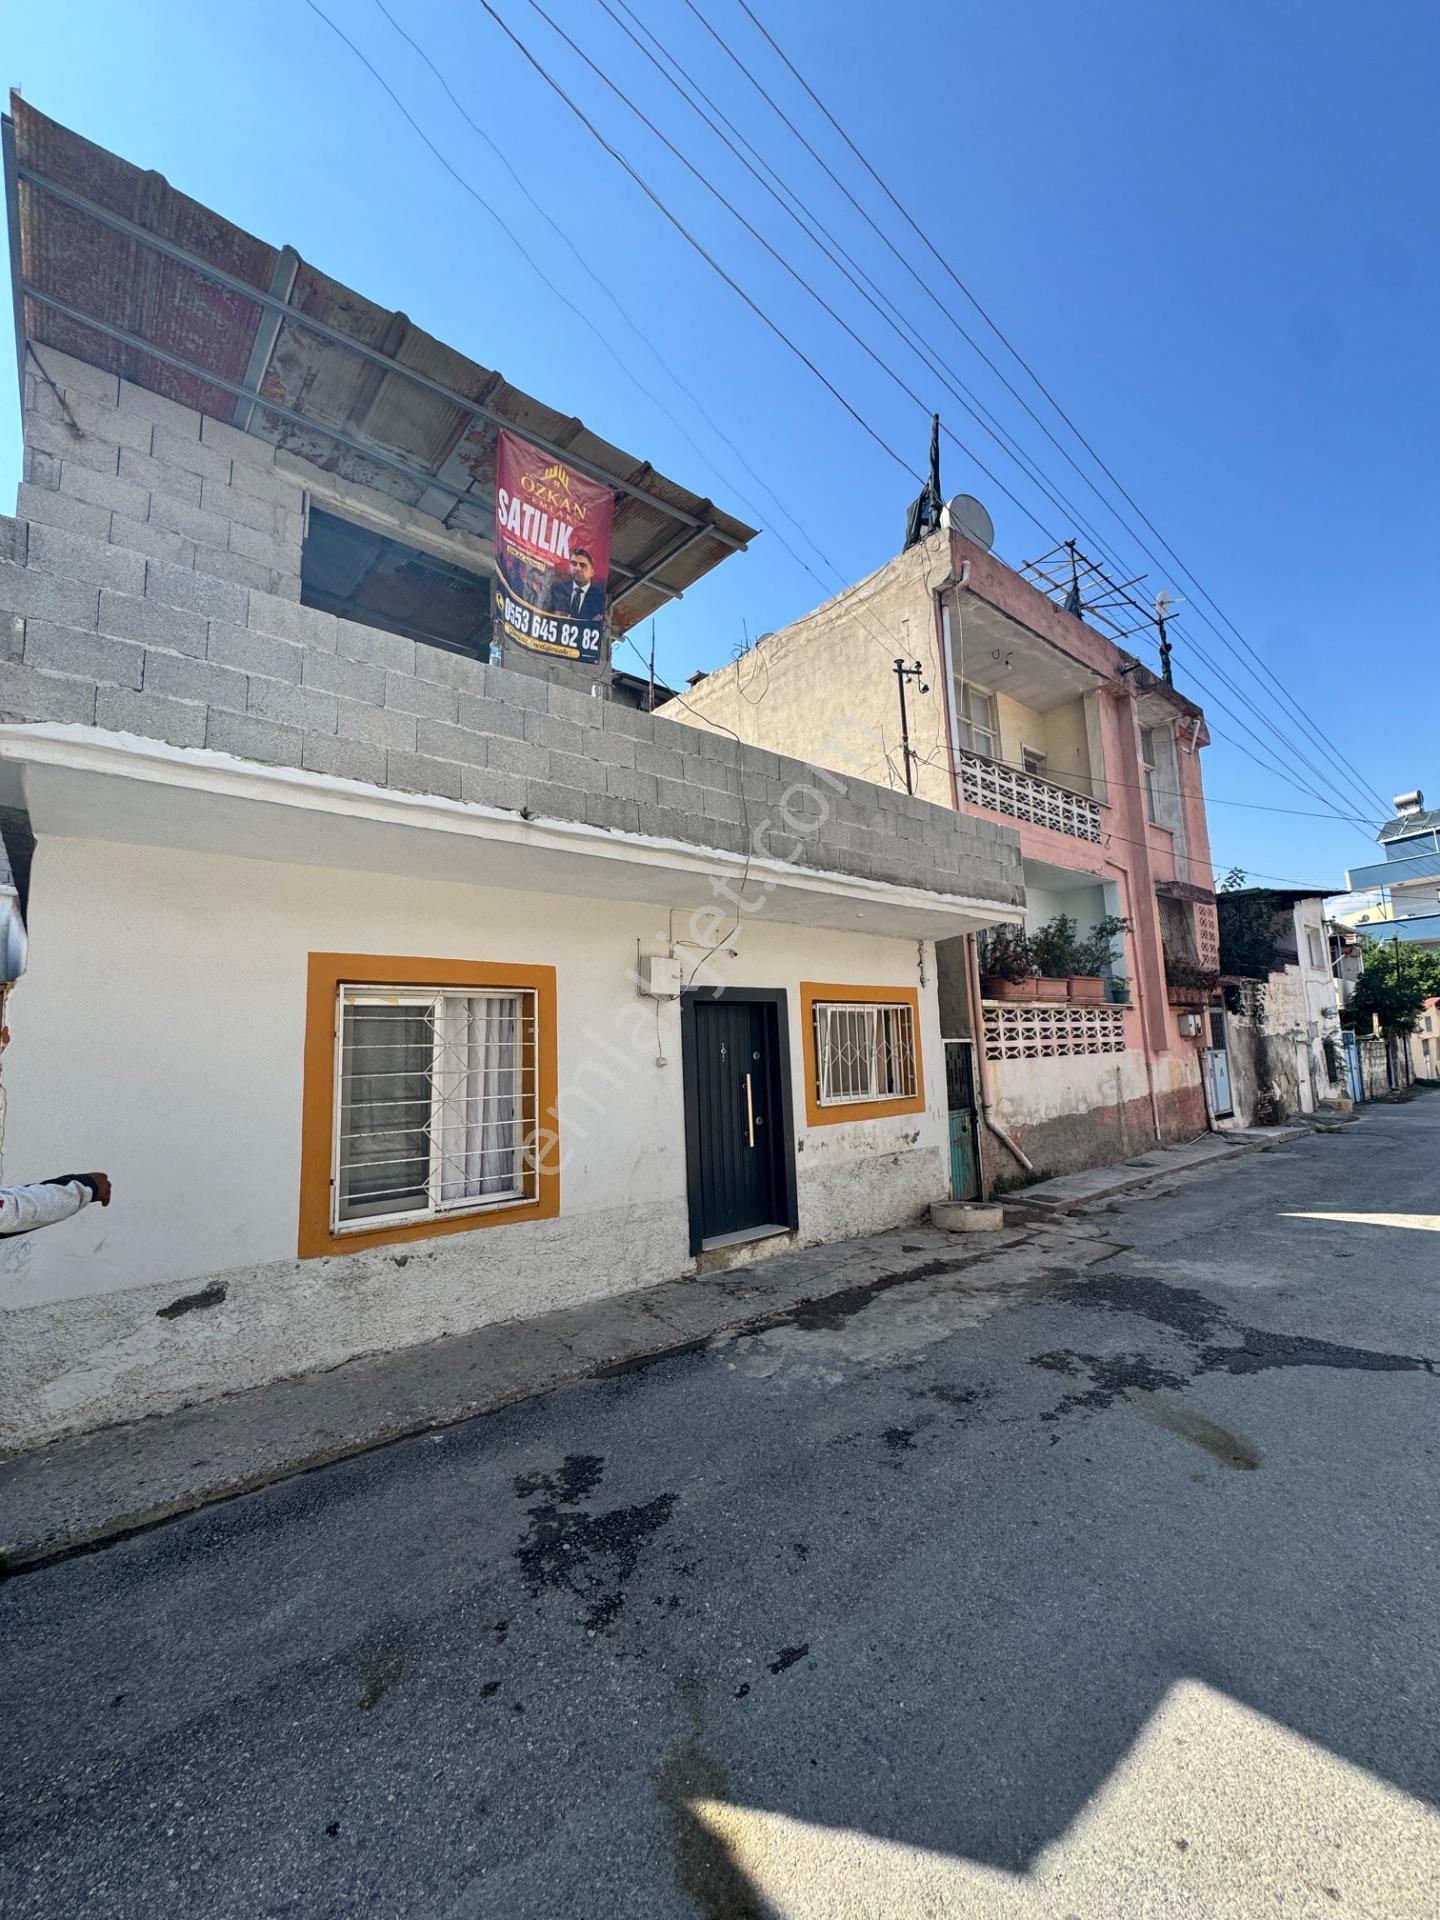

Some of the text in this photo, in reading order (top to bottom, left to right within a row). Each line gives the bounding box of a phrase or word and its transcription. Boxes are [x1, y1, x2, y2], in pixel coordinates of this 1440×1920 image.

[520, 472, 587, 520] ÖZKAN
[498, 488, 574, 560] SATILIK
[504, 597, 530, 633] 0553
[531, 615, 557, 643] 645
[561, 623, 579, 648] 82
[582, 627, 600, 651] 82
